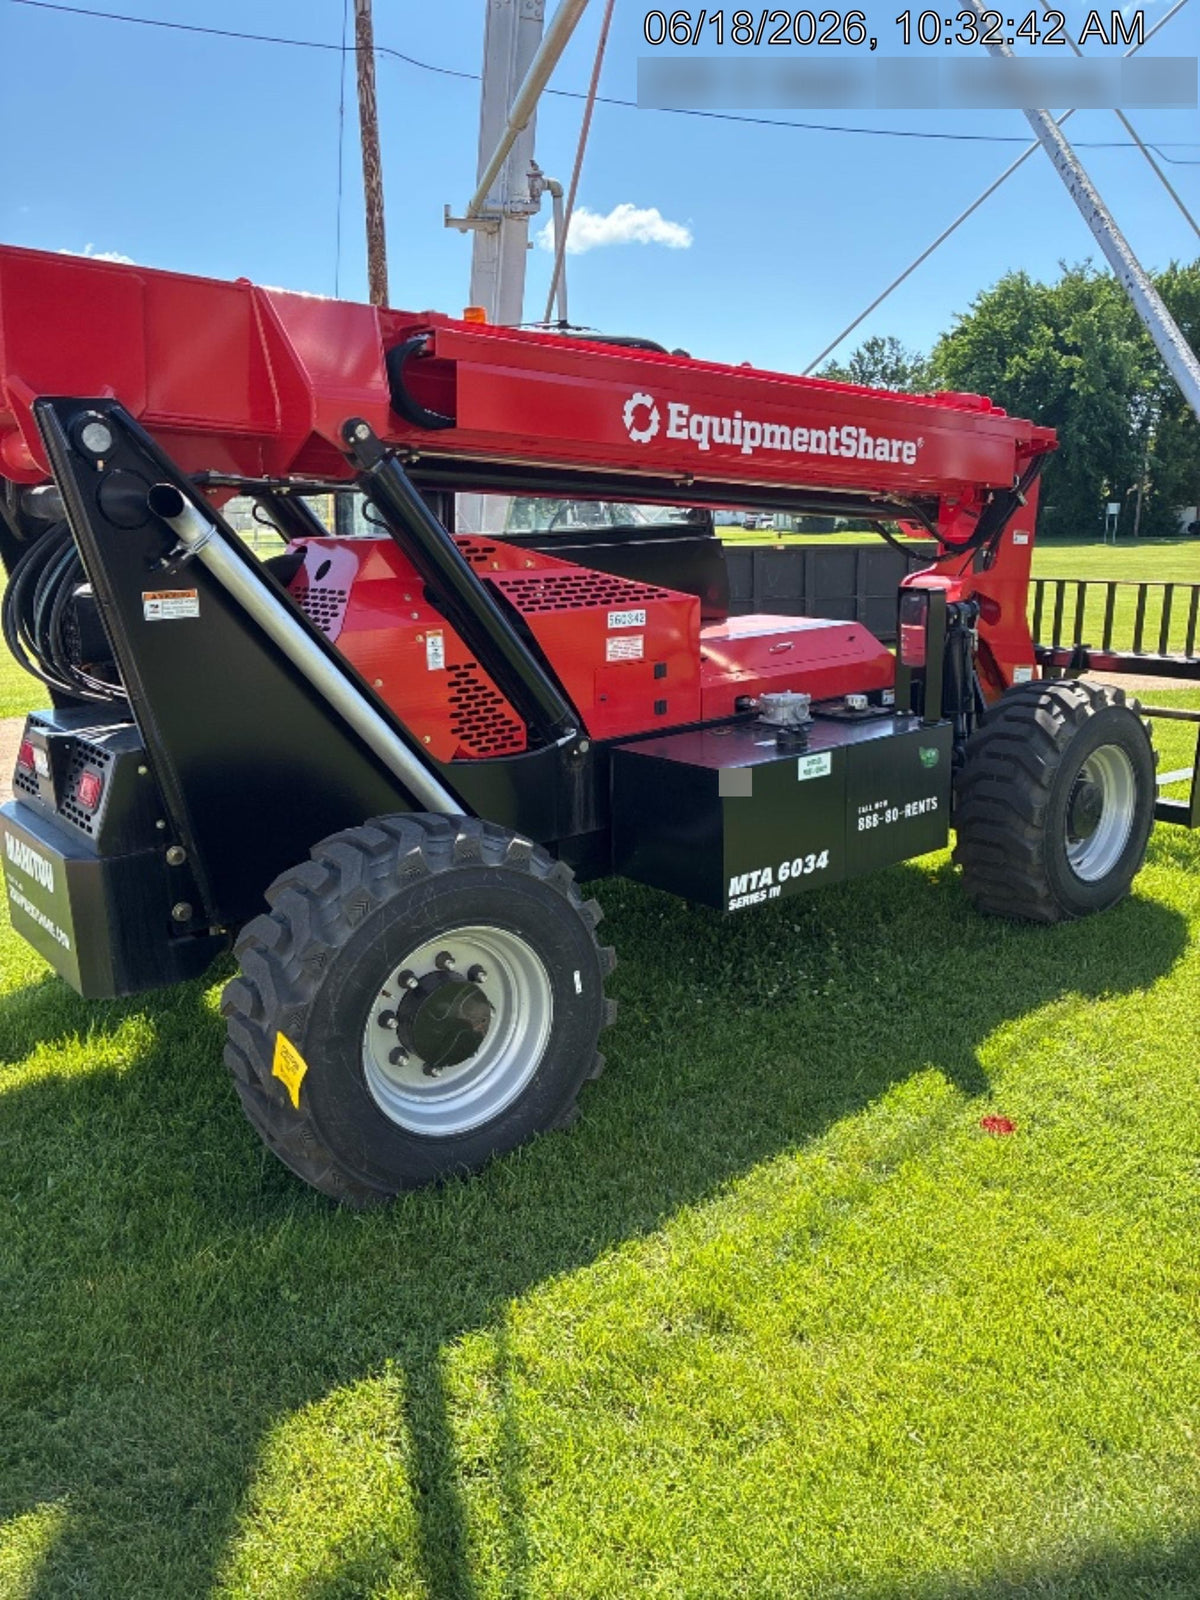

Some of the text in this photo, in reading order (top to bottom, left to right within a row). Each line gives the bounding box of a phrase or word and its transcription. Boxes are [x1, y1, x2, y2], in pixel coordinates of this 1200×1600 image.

[666, 401, 917, 465] EquipmentShare
[857, 796, 938, 831] 888-80-RENTS
[728, 849, 830, 897] MTA 6034
[728, 889, 767, 911] SERIES
